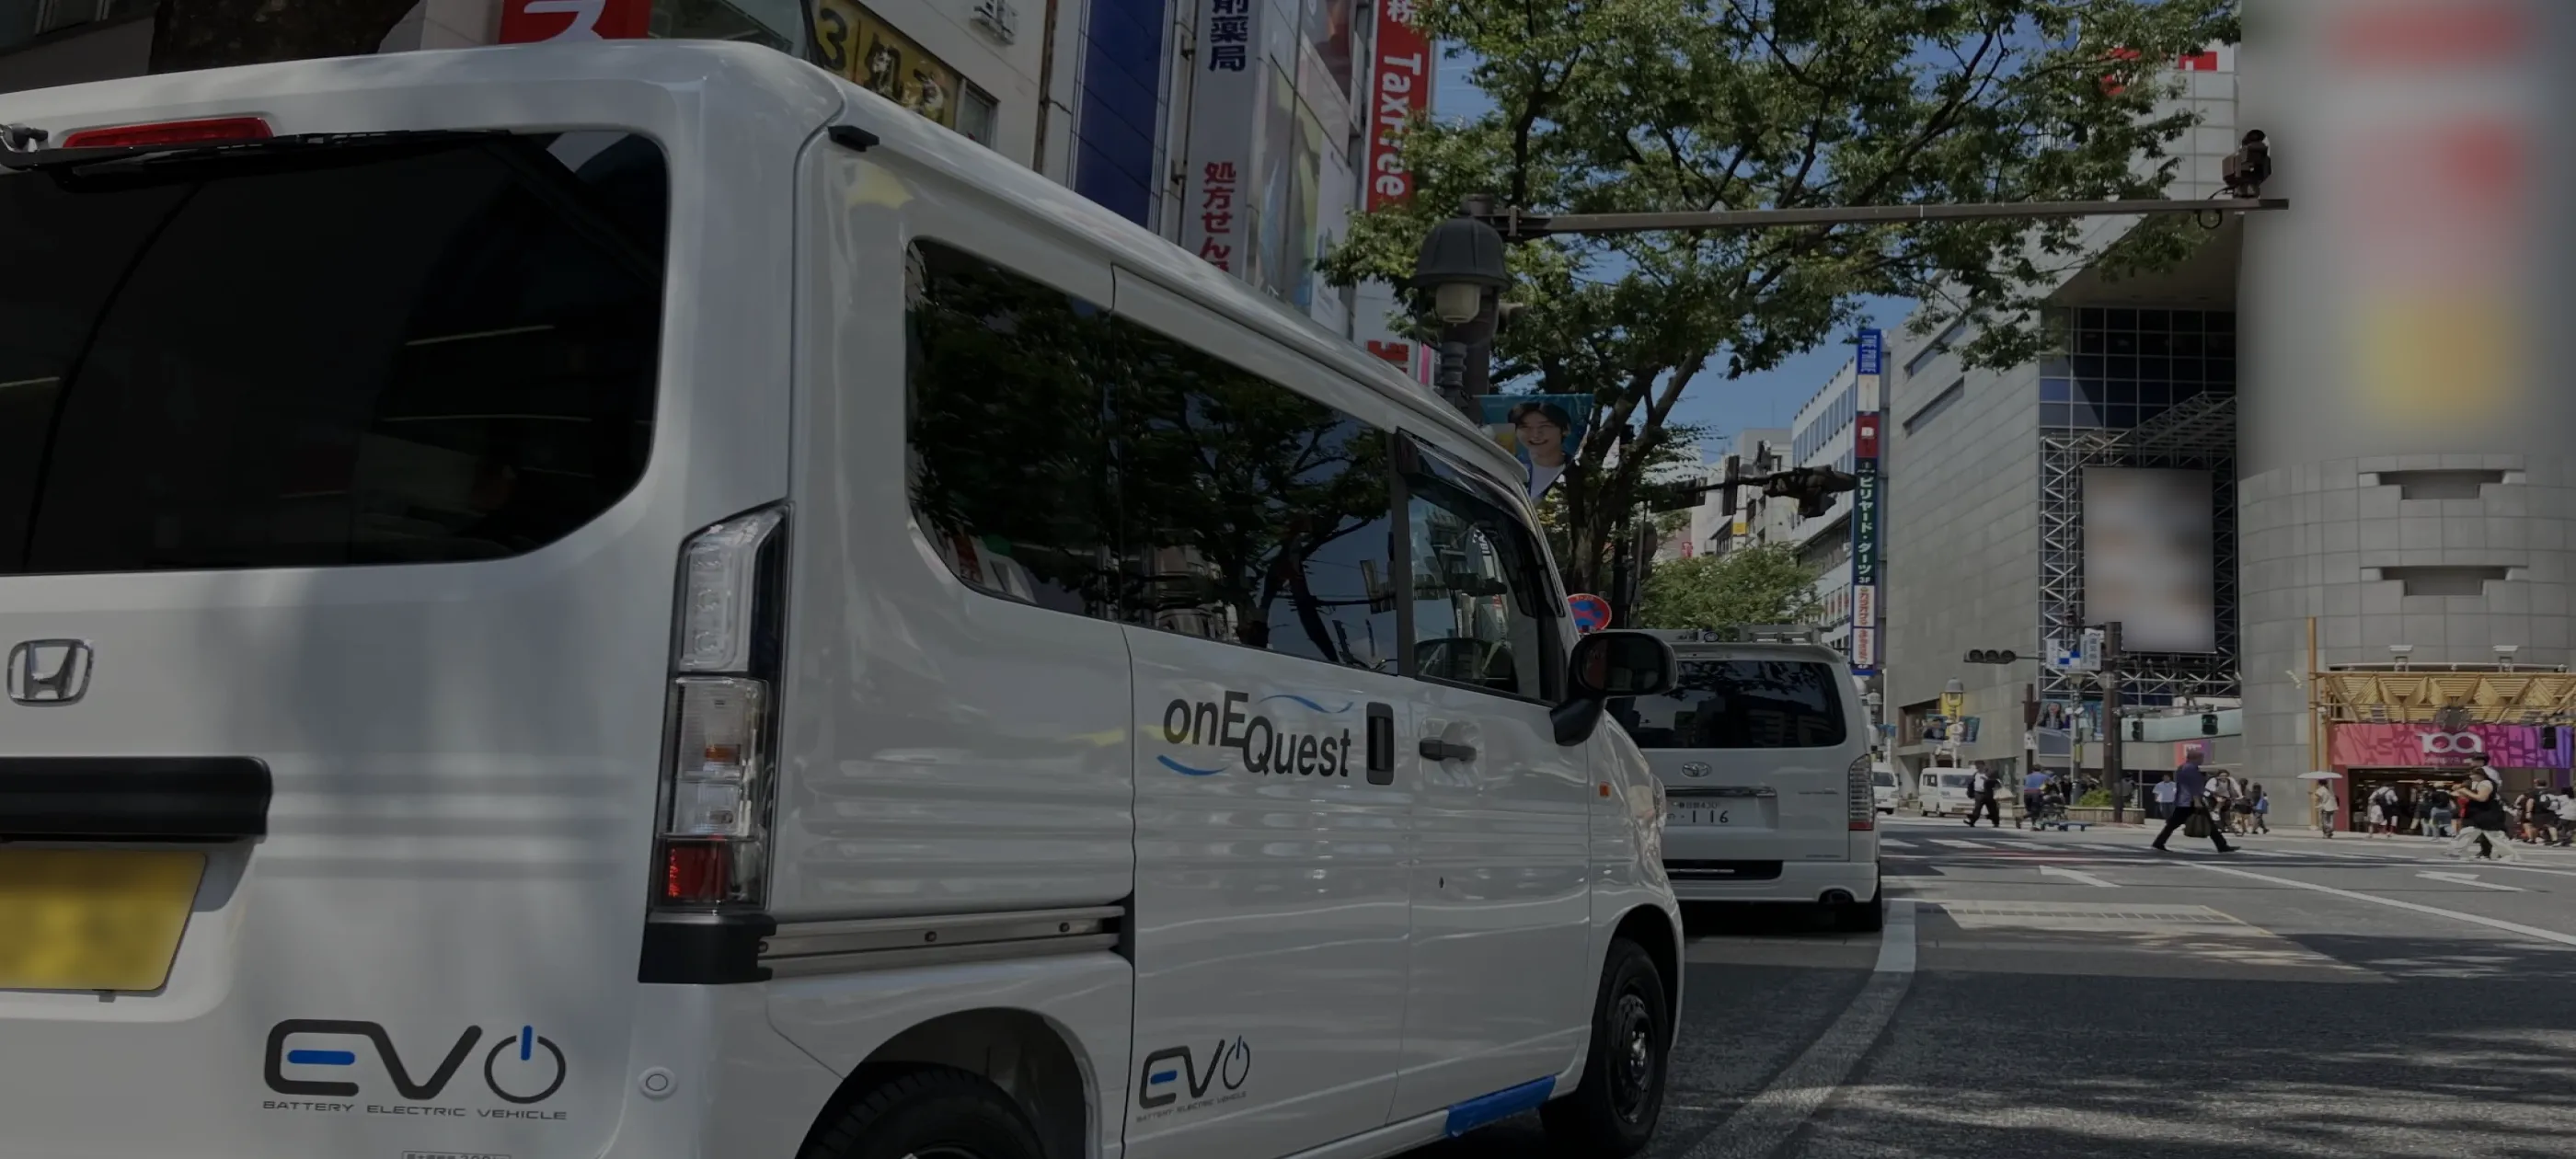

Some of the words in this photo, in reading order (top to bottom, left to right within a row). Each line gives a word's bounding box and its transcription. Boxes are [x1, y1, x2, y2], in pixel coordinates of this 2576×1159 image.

[262, 1100, 355, 1112] BATTERY
[366, 1105, 466, 1117] ELECTRIC
[477, 1108, 567, 1120] VEHICLE
